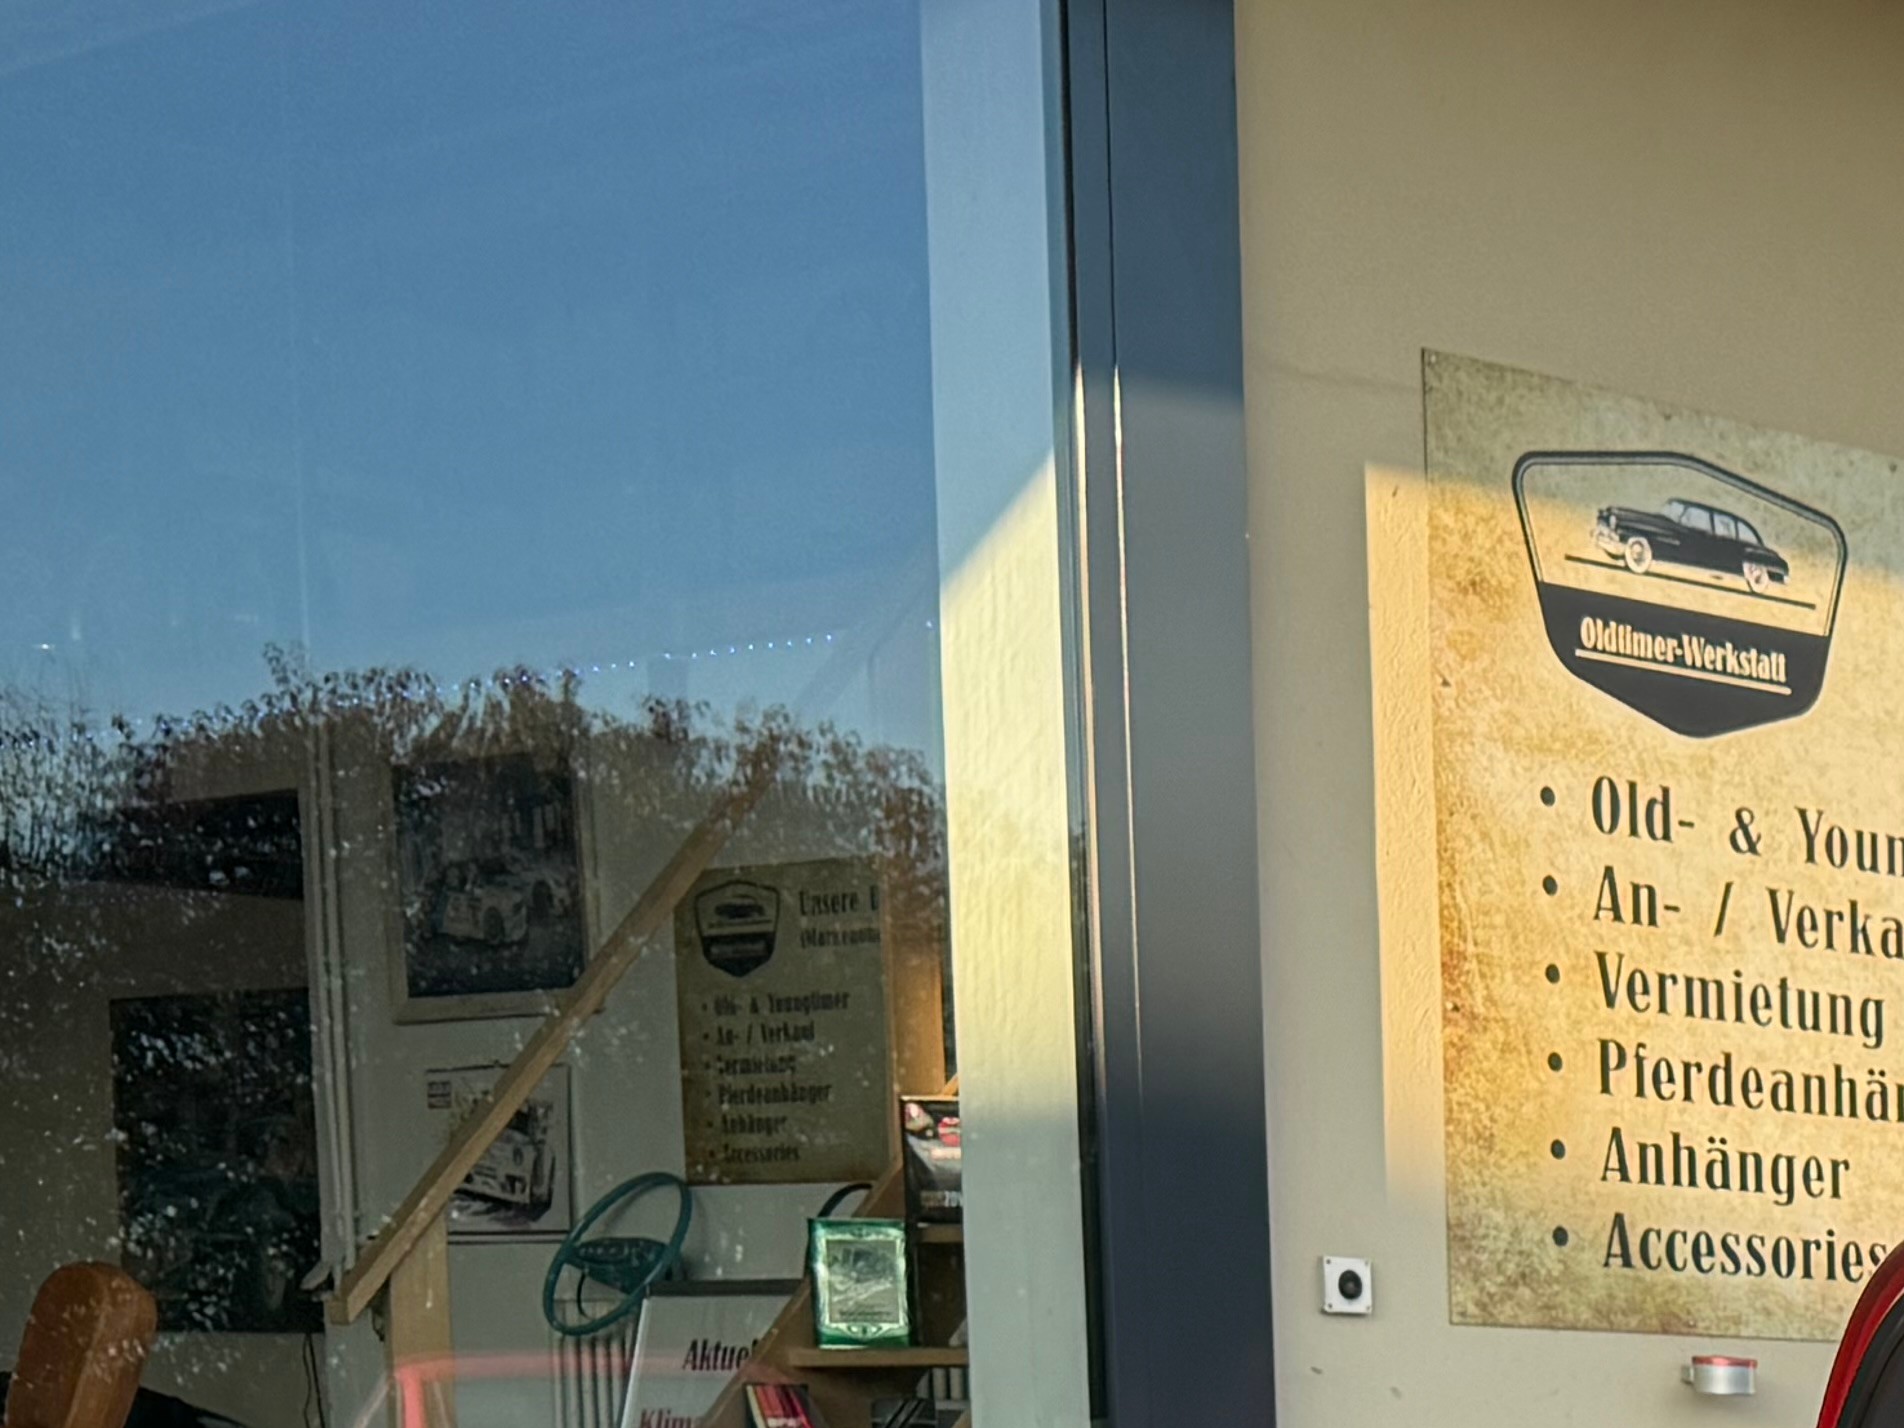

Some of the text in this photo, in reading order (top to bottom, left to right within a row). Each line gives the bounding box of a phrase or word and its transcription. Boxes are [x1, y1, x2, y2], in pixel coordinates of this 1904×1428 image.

[1580, 616, 1786, 683] Oldtimer-Werkstatt
[1592, 776, 1695, 843] Old-
[1729, 807, 1762, 856] &
[1593, 865, 1681, 928] An-
[1594, 950, 1886, 1049] Vermietung
[1601, 1126, 1850, 1206] Anhänger
[1603, 1212, 1887, 1284] Accessories
